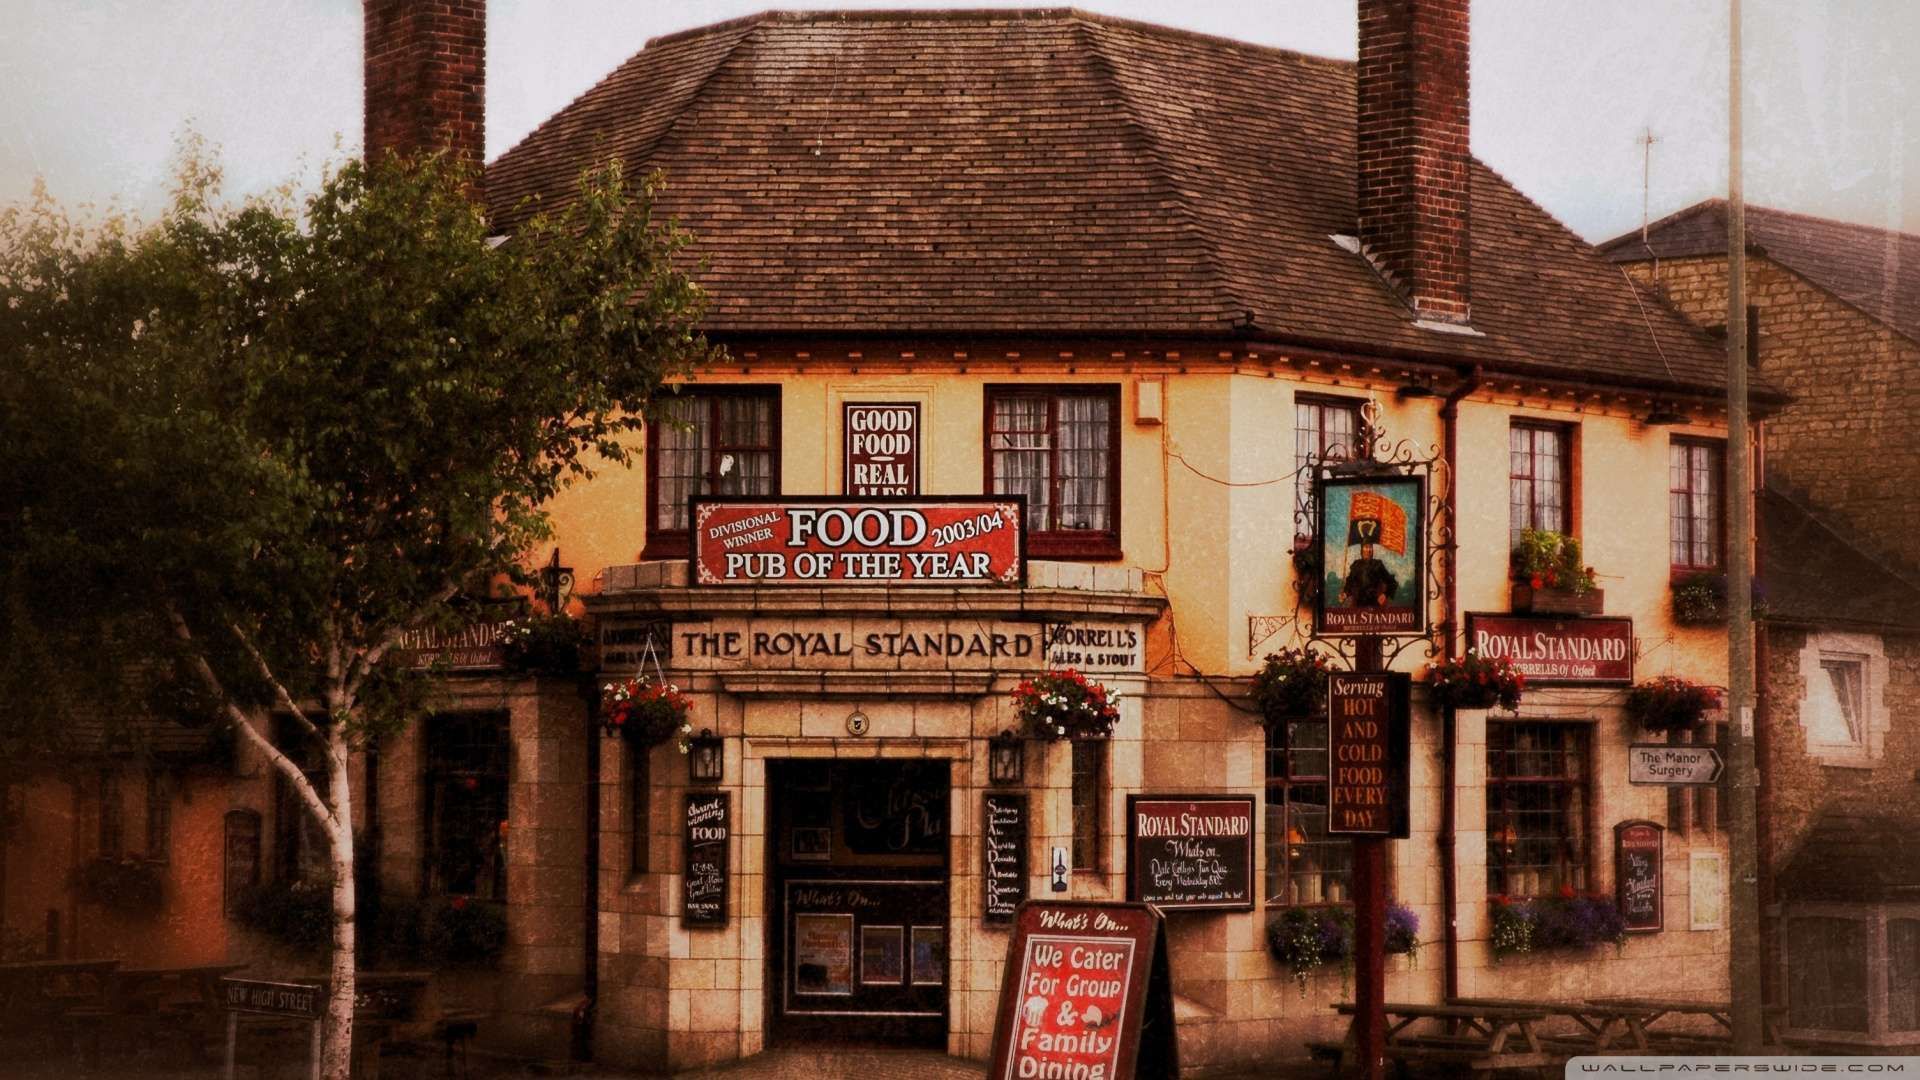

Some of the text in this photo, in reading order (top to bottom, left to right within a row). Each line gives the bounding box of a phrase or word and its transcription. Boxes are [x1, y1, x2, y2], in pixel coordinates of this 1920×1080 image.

[851, 410, 912, 431] GOOD
[852, 433, 911, 455] FOOD
[854, 463, 909, 485] REAL
[709, 511, 781, 539] DIVISIONAL
[787, 508, 927, 547] FOOD
[931, 511, 1003, 548] 2003/04
[723, 527, 774, 550] WINNER
[725, 553, 991, 578] PUB OF THE YEAR
[1326, 611, 1415, 626] ROYAL STANDARD
[681, 632, 741, 657] THE
[753, 632, 853, 657] ROYAL
[865, 632, 1033, 658] STANDARD
[1476, 630, 1626, 661] ROYAL STANDARD
[1086, 653, 1094, 665] &
[1098, 654, 1136, 666] STOUT
[1572, 664, 1596, 677] Oxford
[1334, 677, 1384, 697] Serving
[1343, 699, 1376, 716] HOT
[1343, 722, 1378, 739] AND
[1338, 744, 1382, 762] COLD
[1640, 752, 1701, 764] The Manor
[1339, 767, 1383, 785] FOOD
[1649, 764, 1693, 778] Surgery
[1334, 787, 1386, 805] EVERY
[1138, 813, 1249, 837] ROYAL STANDARD
[1344, 810, 1375, 828] DAY
[692, 827, 726, 840] FOOD
[1165, 837, 1204, 858] What's
[794, 889, 842, 907] What's
[1040, 910, 1128, 931] What's On...
[1034, 945, 1124, 970] We Cater
[1027, 972, 1121, 998] For Group
[228, 983, 314, 1012] NEW HIGH STREET
[1057, 1000, 1078, 1026] &
[1021, 1027, 1112, 1054] Family
[1019, 1056, 1106, 1080] Dining
